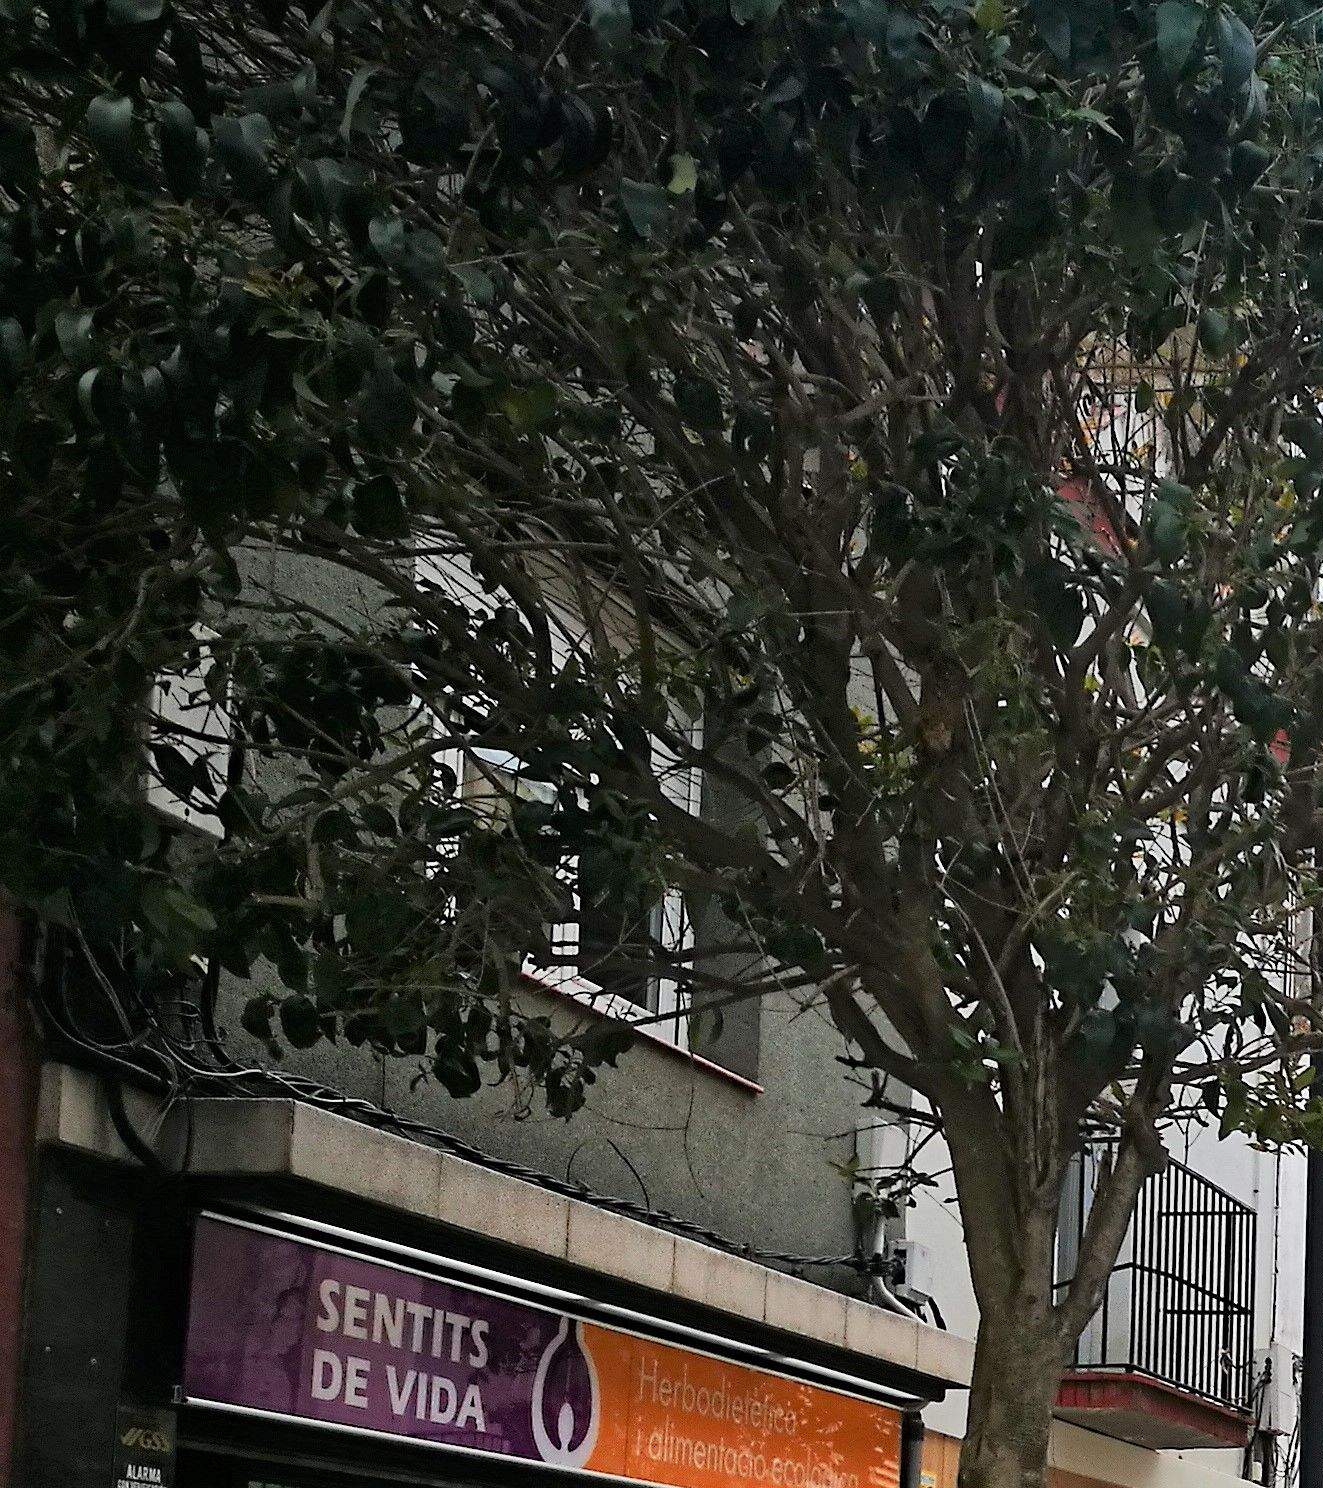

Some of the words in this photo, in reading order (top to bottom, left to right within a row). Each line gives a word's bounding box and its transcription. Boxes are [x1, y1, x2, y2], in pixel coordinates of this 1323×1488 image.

[316, 1279, 490, 1368] SENTITS
[311, 1348, 371, 1409] DE
[386, 1364, 487, 1432] VIDA
[126, 1464, 161, 1483] ALARMA
